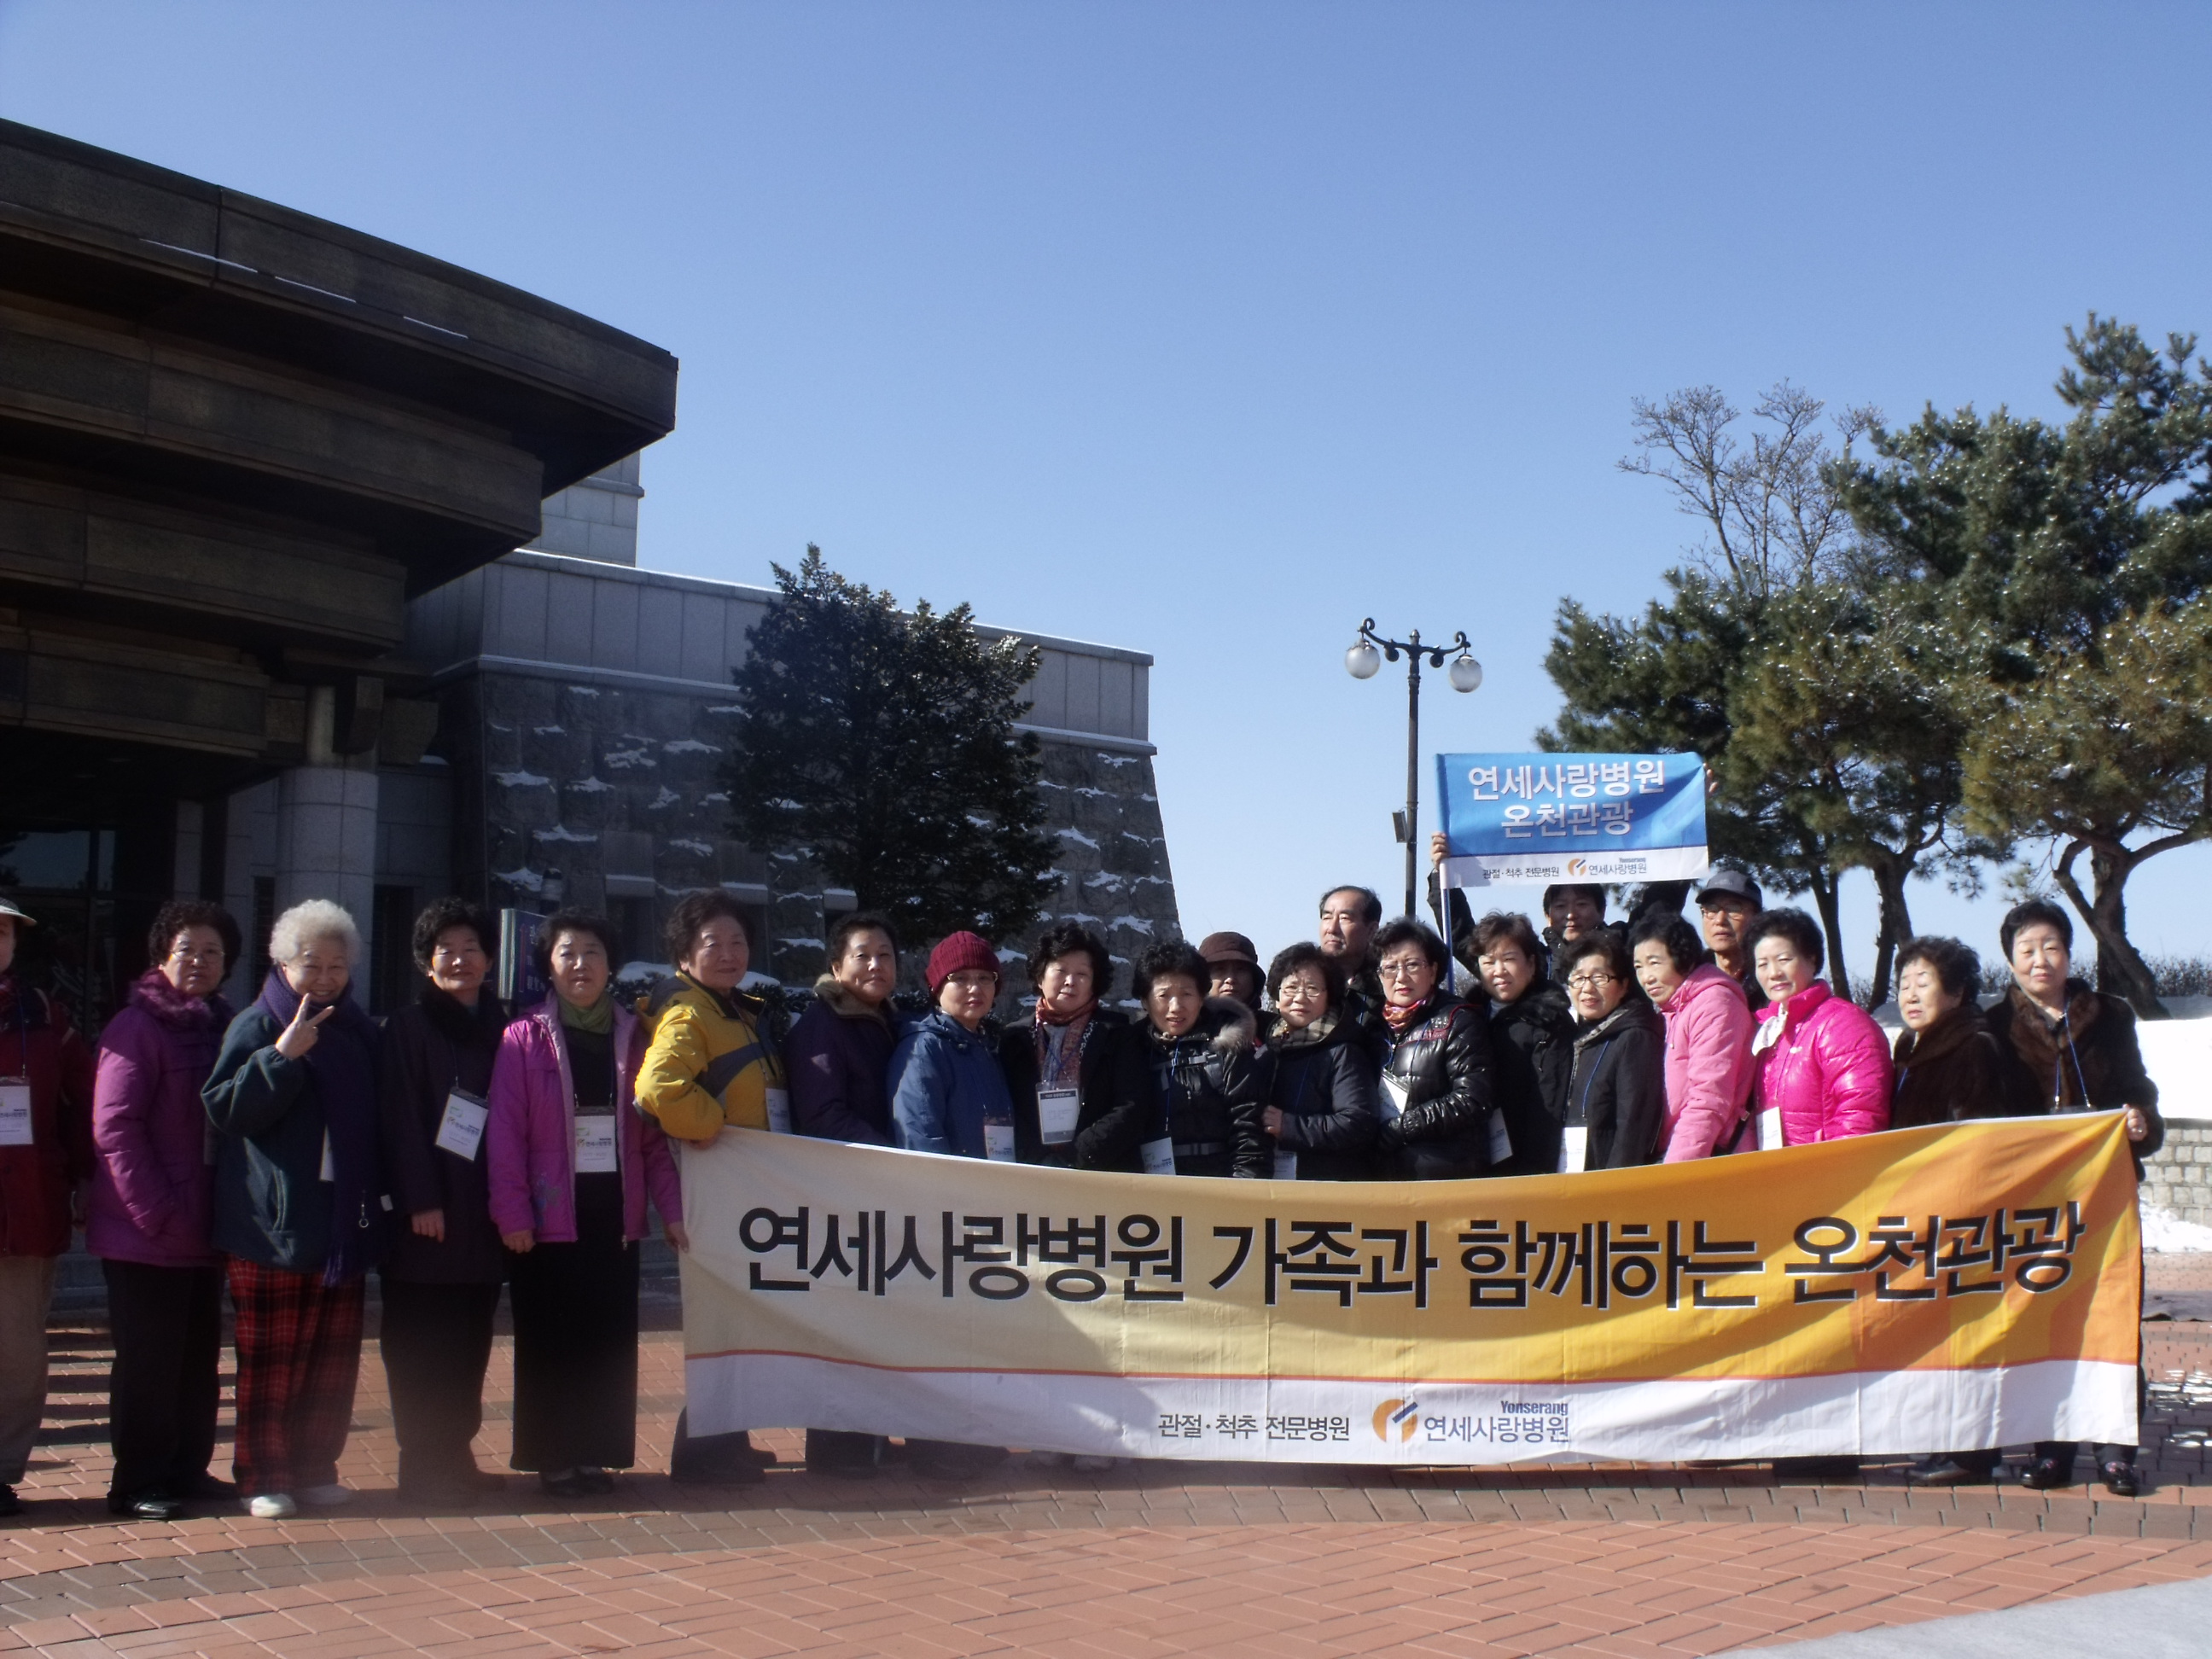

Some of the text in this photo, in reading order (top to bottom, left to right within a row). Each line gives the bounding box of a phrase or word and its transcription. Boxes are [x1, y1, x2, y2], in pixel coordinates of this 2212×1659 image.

[1468, 760, 1664, 800] 연세사랑병원
[1501, 802, 1633, 838] 온천관광
[1525, 867, 1560, 878] 전문병원
[1588, 863, 1647, 876] 연세사랑병원
[738, 1201, 2087, 1309] 연세사랑병원 가족과 함께하는 온천관광
[1500, 1400, 1569, 1416] Yonserang
[1265, 1416, 1350, 1441] 전문병원
[1423, 1415, 1569, 1443] 연세사랑병원
